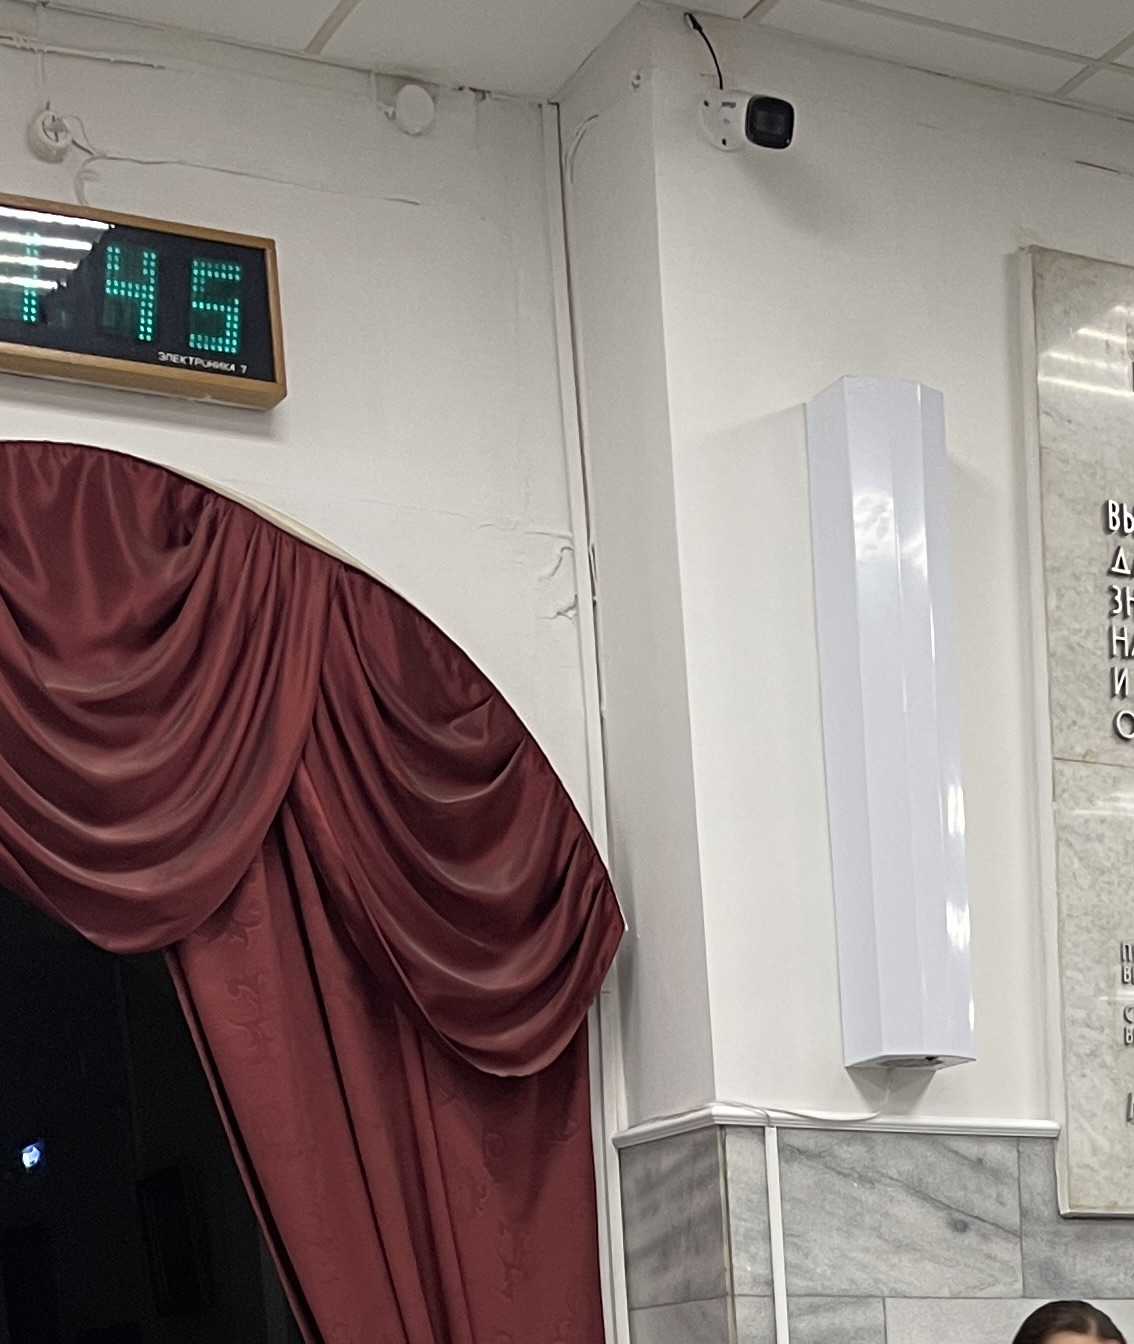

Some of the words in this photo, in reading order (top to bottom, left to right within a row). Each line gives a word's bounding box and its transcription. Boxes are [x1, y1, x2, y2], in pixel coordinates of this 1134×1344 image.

[158, 351, 236, 372] ЭЛЕКТРОНИКА
[240, 364, 247, 374] 7
[1110, 666, 1130, 699] И
